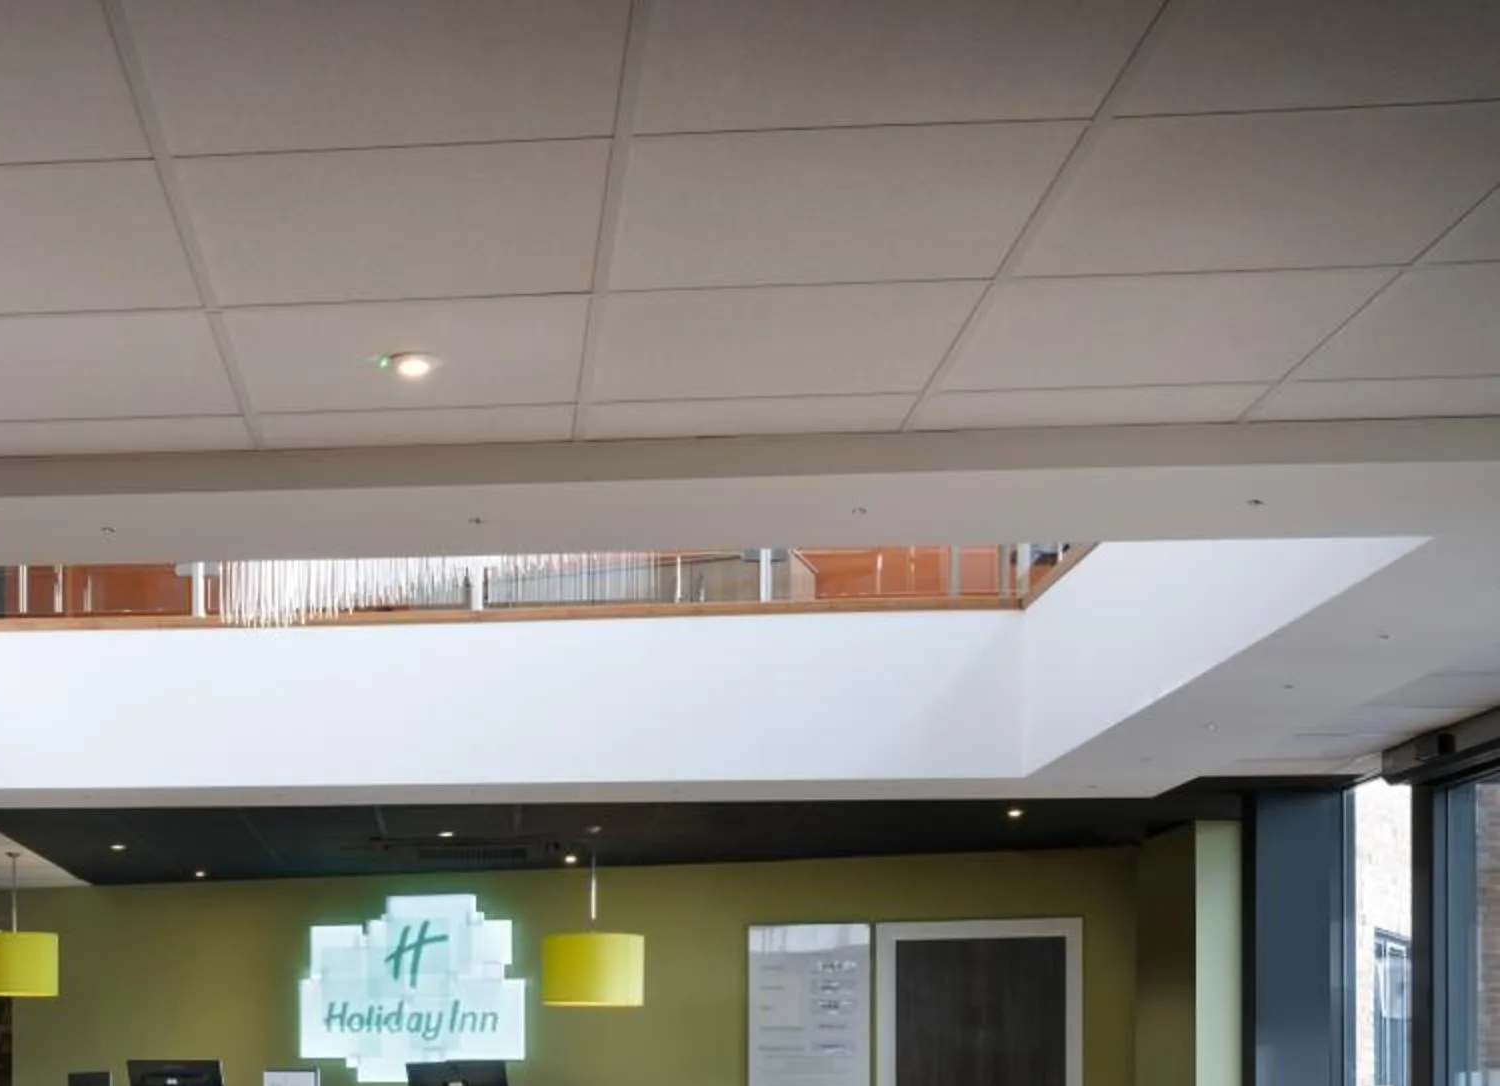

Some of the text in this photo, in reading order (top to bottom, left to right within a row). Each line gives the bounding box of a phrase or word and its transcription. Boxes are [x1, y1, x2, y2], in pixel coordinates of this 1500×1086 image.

[385, 920, 449, 989] H
[324, 1000, 500, 1040] Holiday Inn
